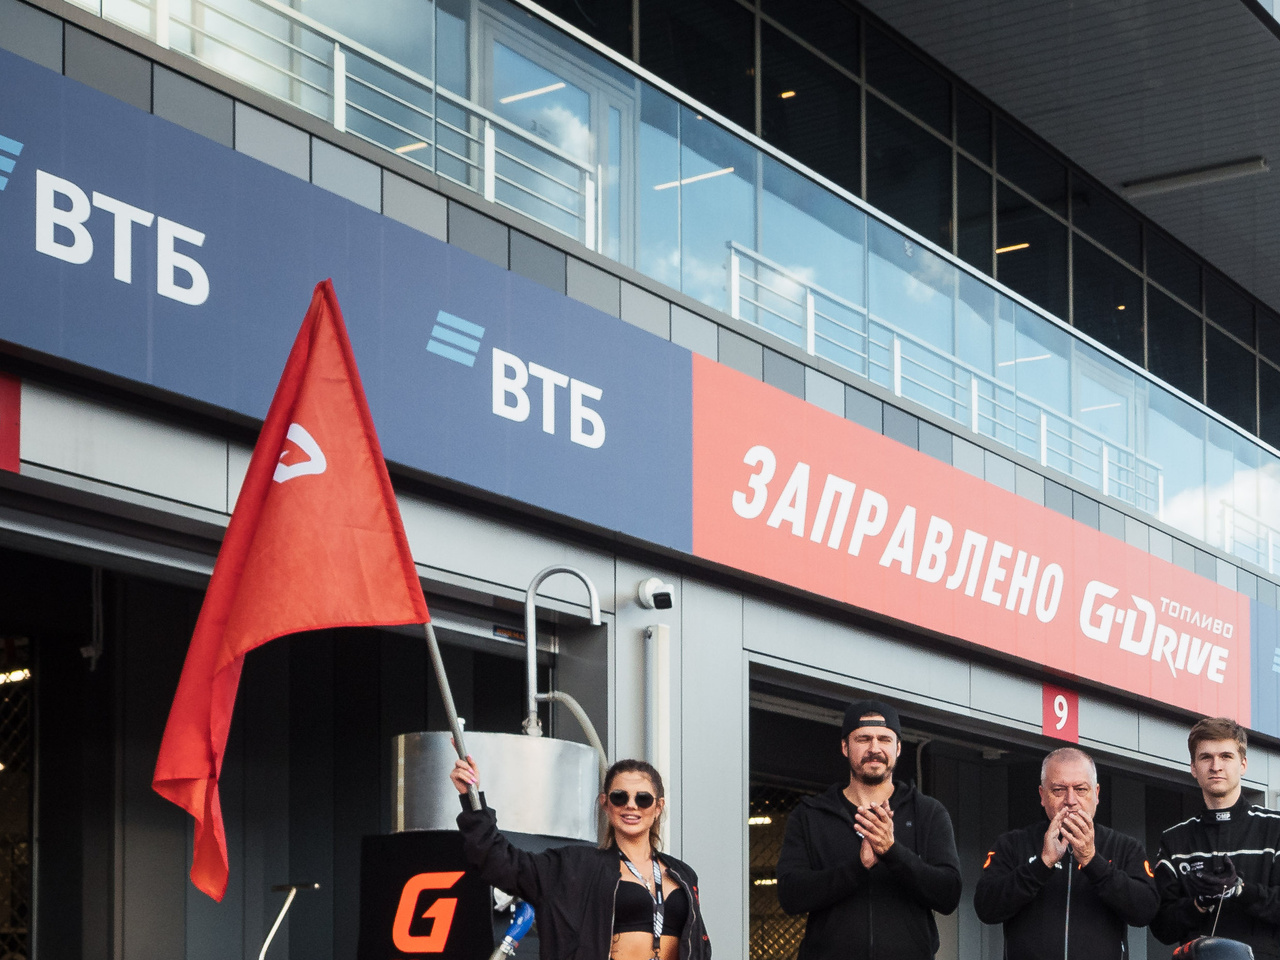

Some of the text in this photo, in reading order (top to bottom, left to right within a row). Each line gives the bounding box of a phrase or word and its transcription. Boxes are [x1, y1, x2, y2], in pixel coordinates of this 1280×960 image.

[35, 168, 211, 306] ВТБ
[491, 346, 607, 449] ВТБ
[731, 444, 1065, 624] ЗАПРАВЛЕНО
[1159, 596, 1234, 640] ТОПЛИВО
[1053, 694, 1069, 731] 9
[392, 871, 466, 953] G
